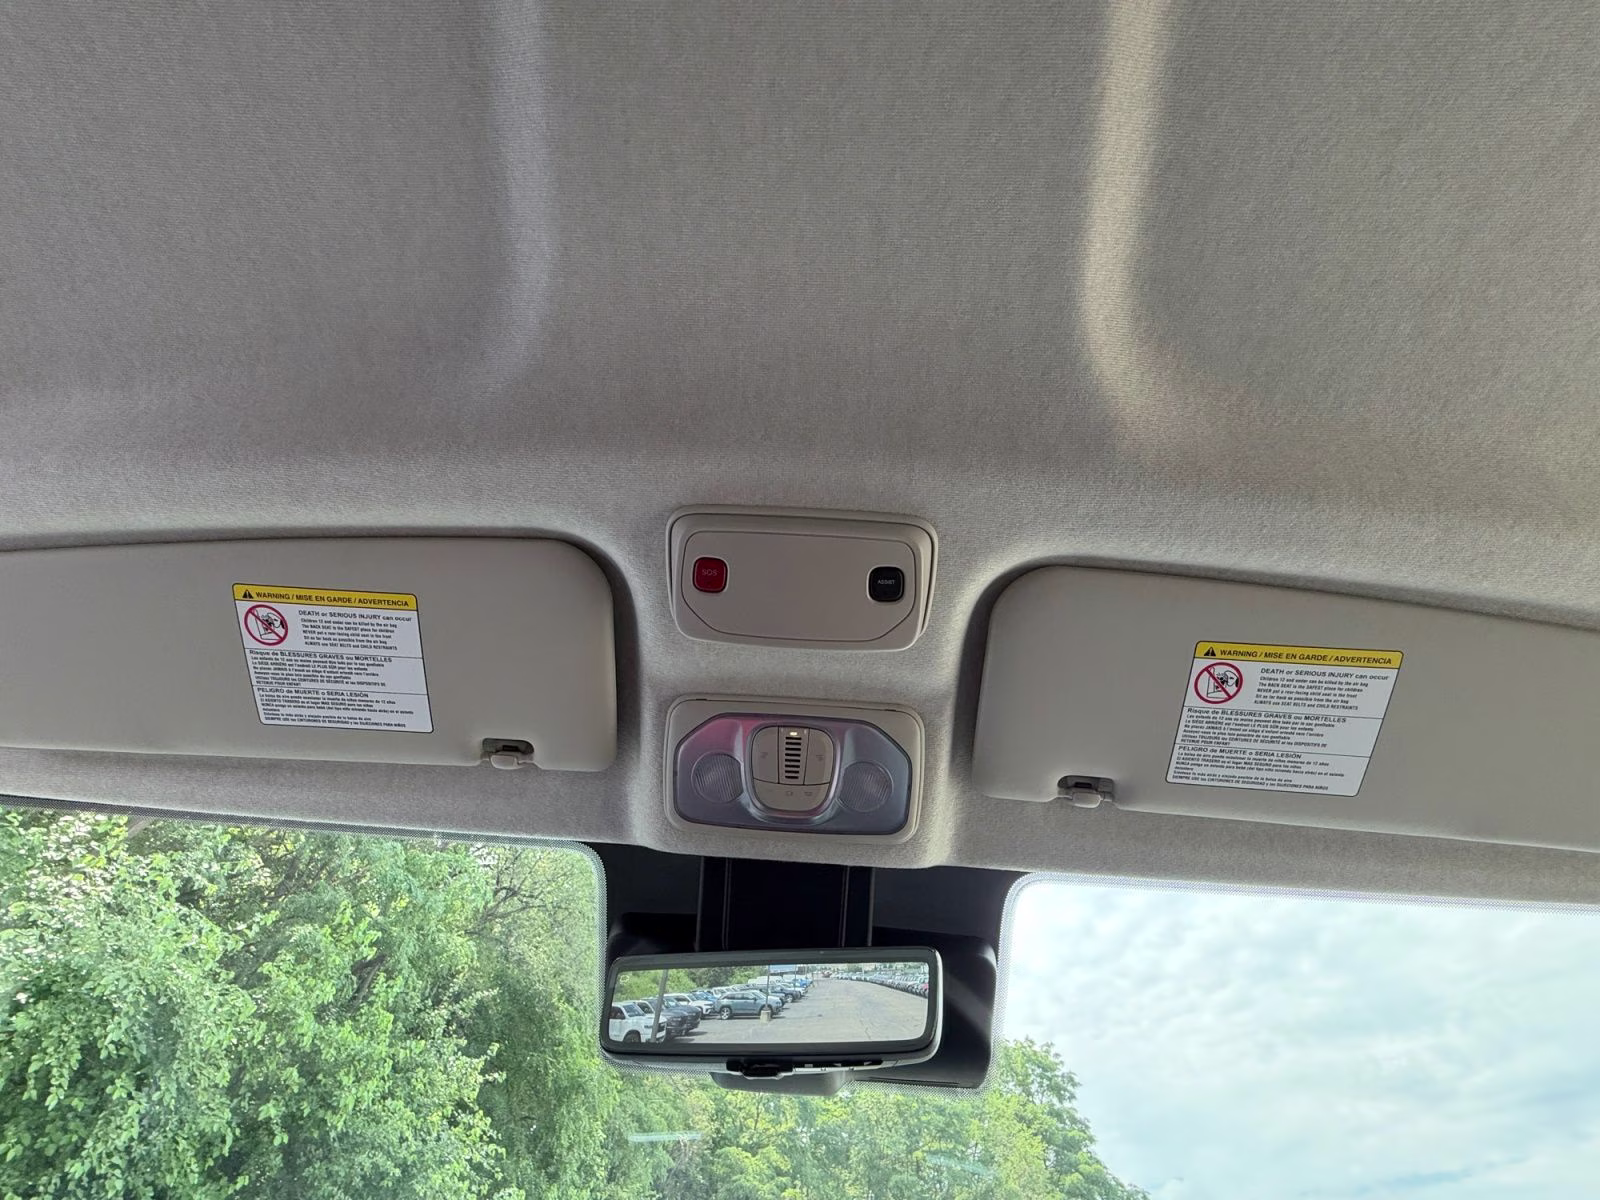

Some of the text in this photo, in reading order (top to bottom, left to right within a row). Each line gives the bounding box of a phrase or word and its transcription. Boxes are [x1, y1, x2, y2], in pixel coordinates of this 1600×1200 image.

[702, 568, 718, 577] SOS
[255, 591, 290, 599] WARNING
[326, 595, 352, 603] GARDE
[357, 597, 409, 606] ADVERTENCIA
[1219, 649, 1258, 657] WARNING
[1298, 653, 1328, 661] GARDE
[1333, 655, 1393, 664] ADVERTENCIA
